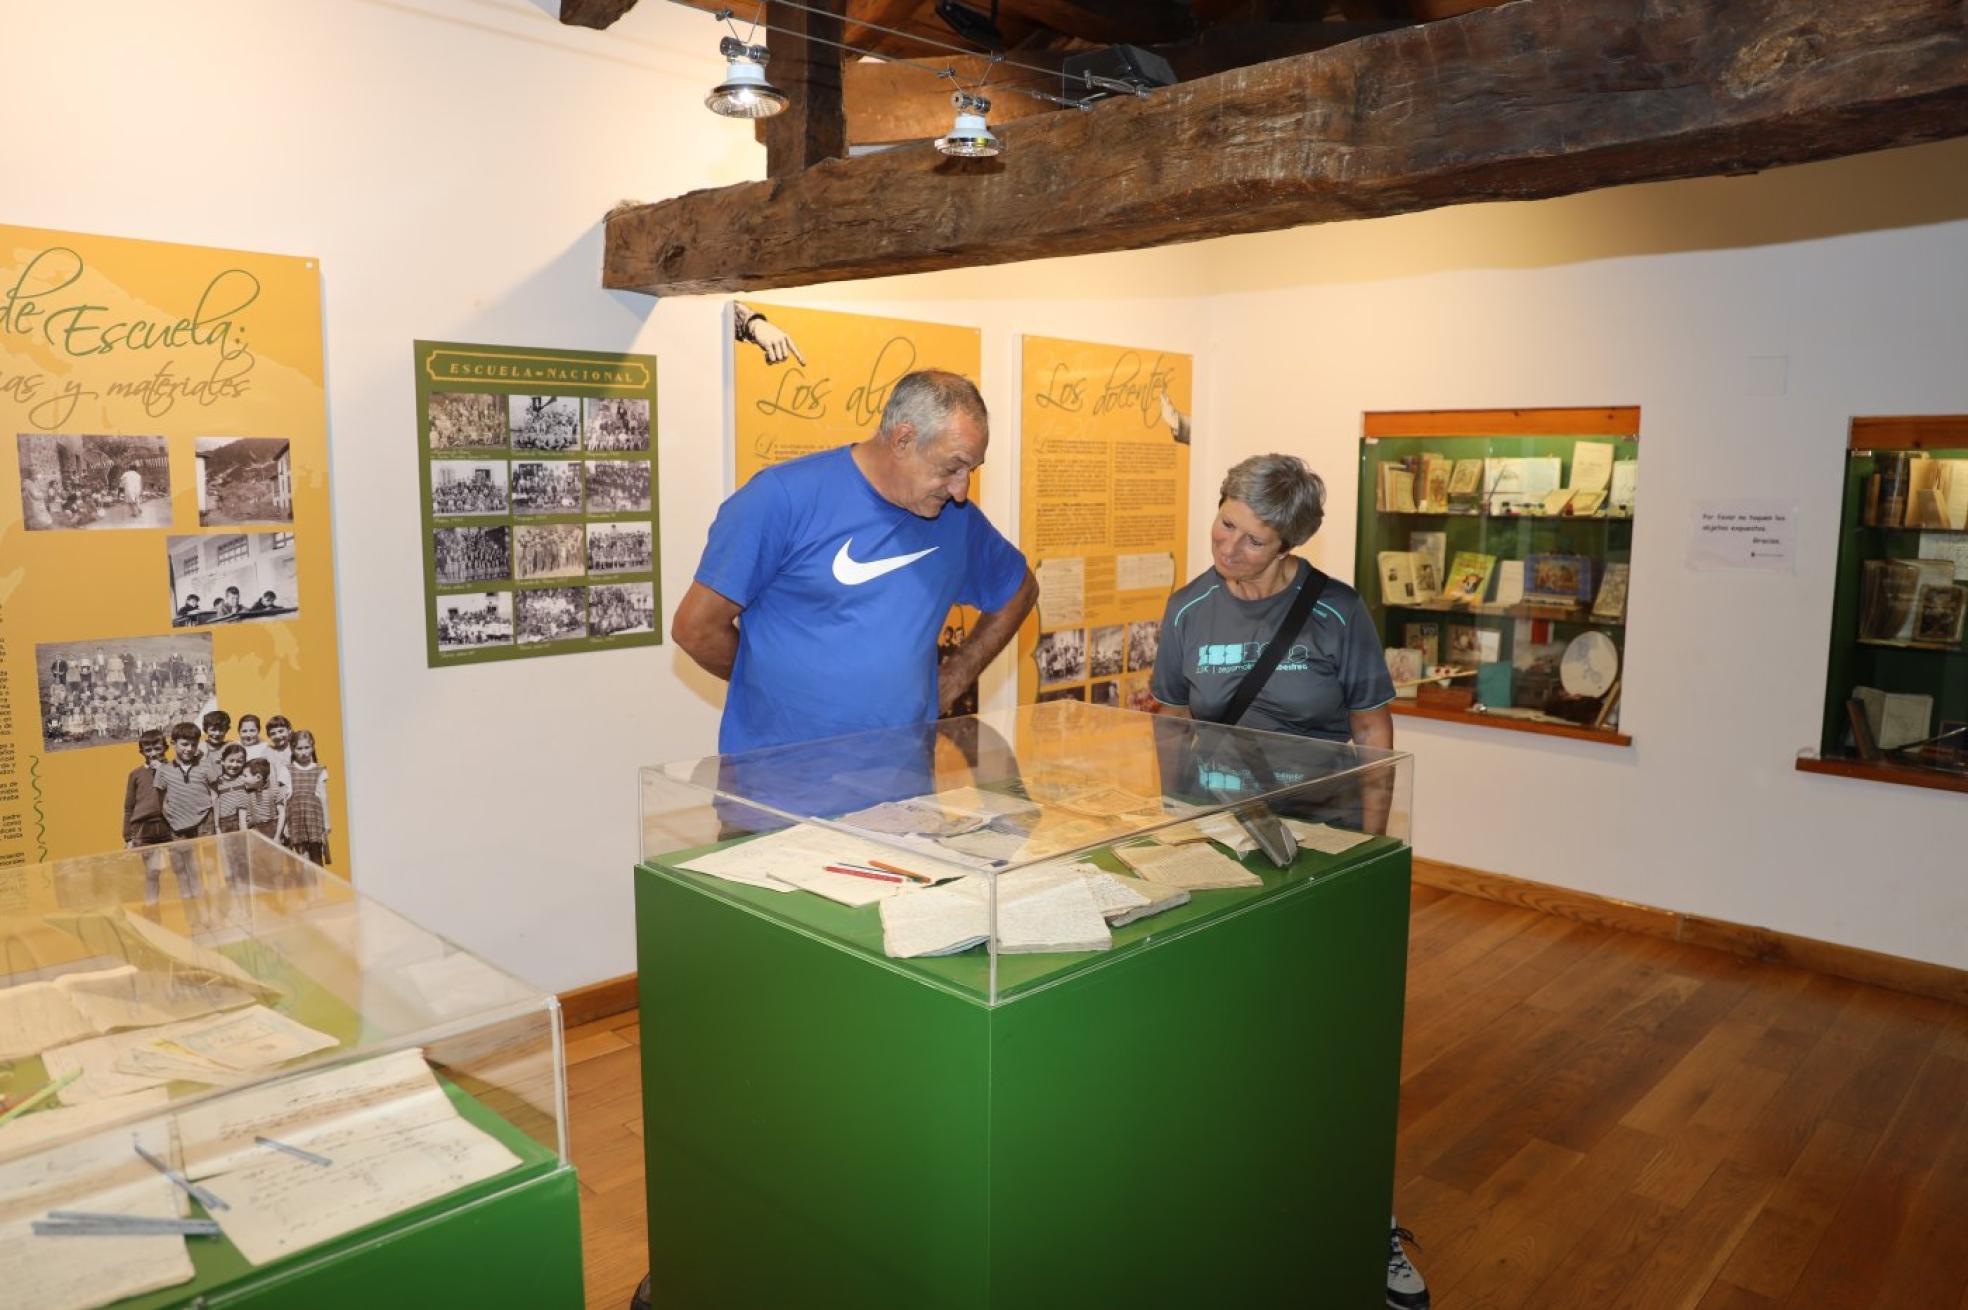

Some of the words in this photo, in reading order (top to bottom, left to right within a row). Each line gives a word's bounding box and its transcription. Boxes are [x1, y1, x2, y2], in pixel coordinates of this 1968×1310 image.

[44, 269, 261, 360] Escuela:
[28, 380, 99, 430] y
[106, 350, 256, 418] materiales
[450, 362, 532, 379] ESCUELA
[546, 366, 634, 384] NACIONAL
[756, 368, 832, 420] Los
[1035, 362, 1087, 413] Los
